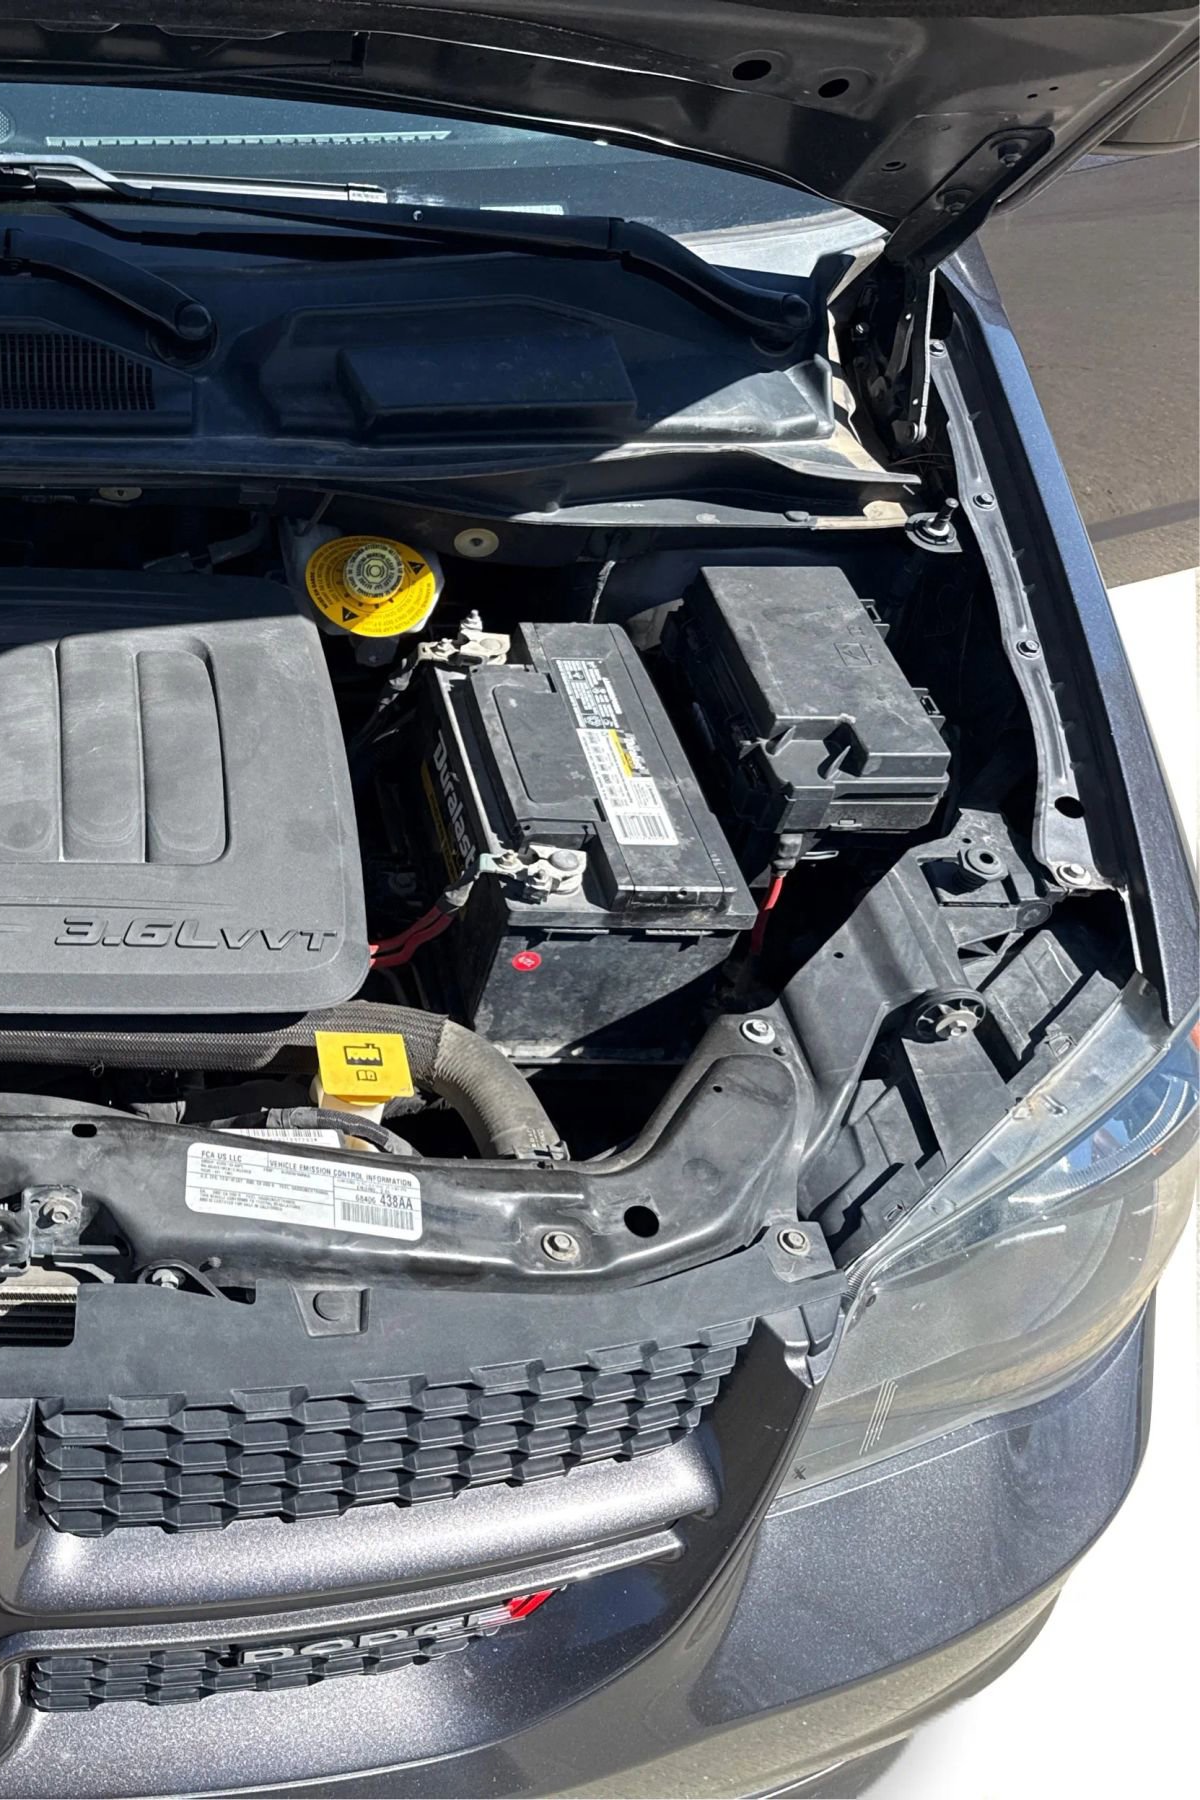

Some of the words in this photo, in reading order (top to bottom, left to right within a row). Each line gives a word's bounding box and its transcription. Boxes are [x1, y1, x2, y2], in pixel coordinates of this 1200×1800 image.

[432, 729, 476, 870] Duralast
[201, 1150, 215, 1159] FCA
[217, 1153, 227, 1161] US
[229, 1154, 242, 1163] LLC
[270, 1160, 296, 1169] VEHICLE
[299, 1164, 331, 1175] EMISSION
[333, 1169, 362, 1180] CONTROL
[366, 1174, 412, 1187] INFORMATION
[380, 1194, 413, 1210] 438AA
